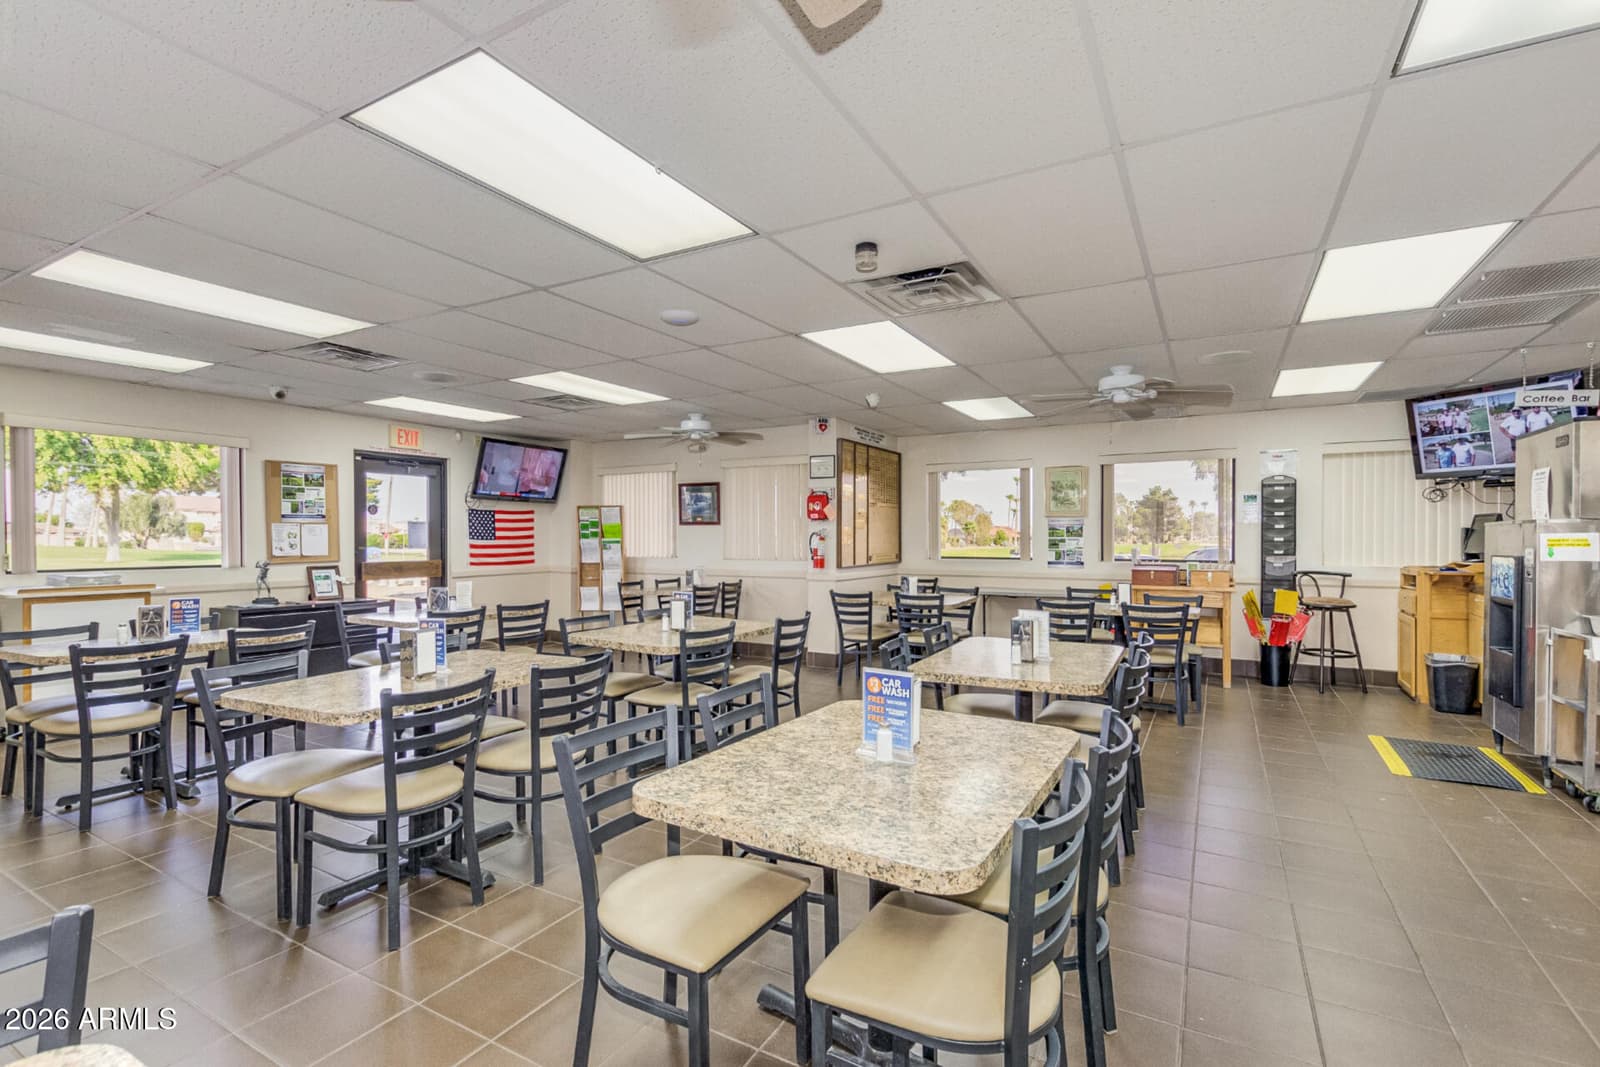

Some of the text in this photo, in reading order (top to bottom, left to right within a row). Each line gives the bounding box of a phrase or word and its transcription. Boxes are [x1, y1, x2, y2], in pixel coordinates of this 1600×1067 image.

[1522, 394, 1591, 403] Coffee Bar
[398, 428, 419, 448] EXIT
[882, 678, 901, 688] CAR
[882, 687, 909, 698] WASH
[868, 696, 885, 704] FREE
[868, 705, 885, 713] FREE
